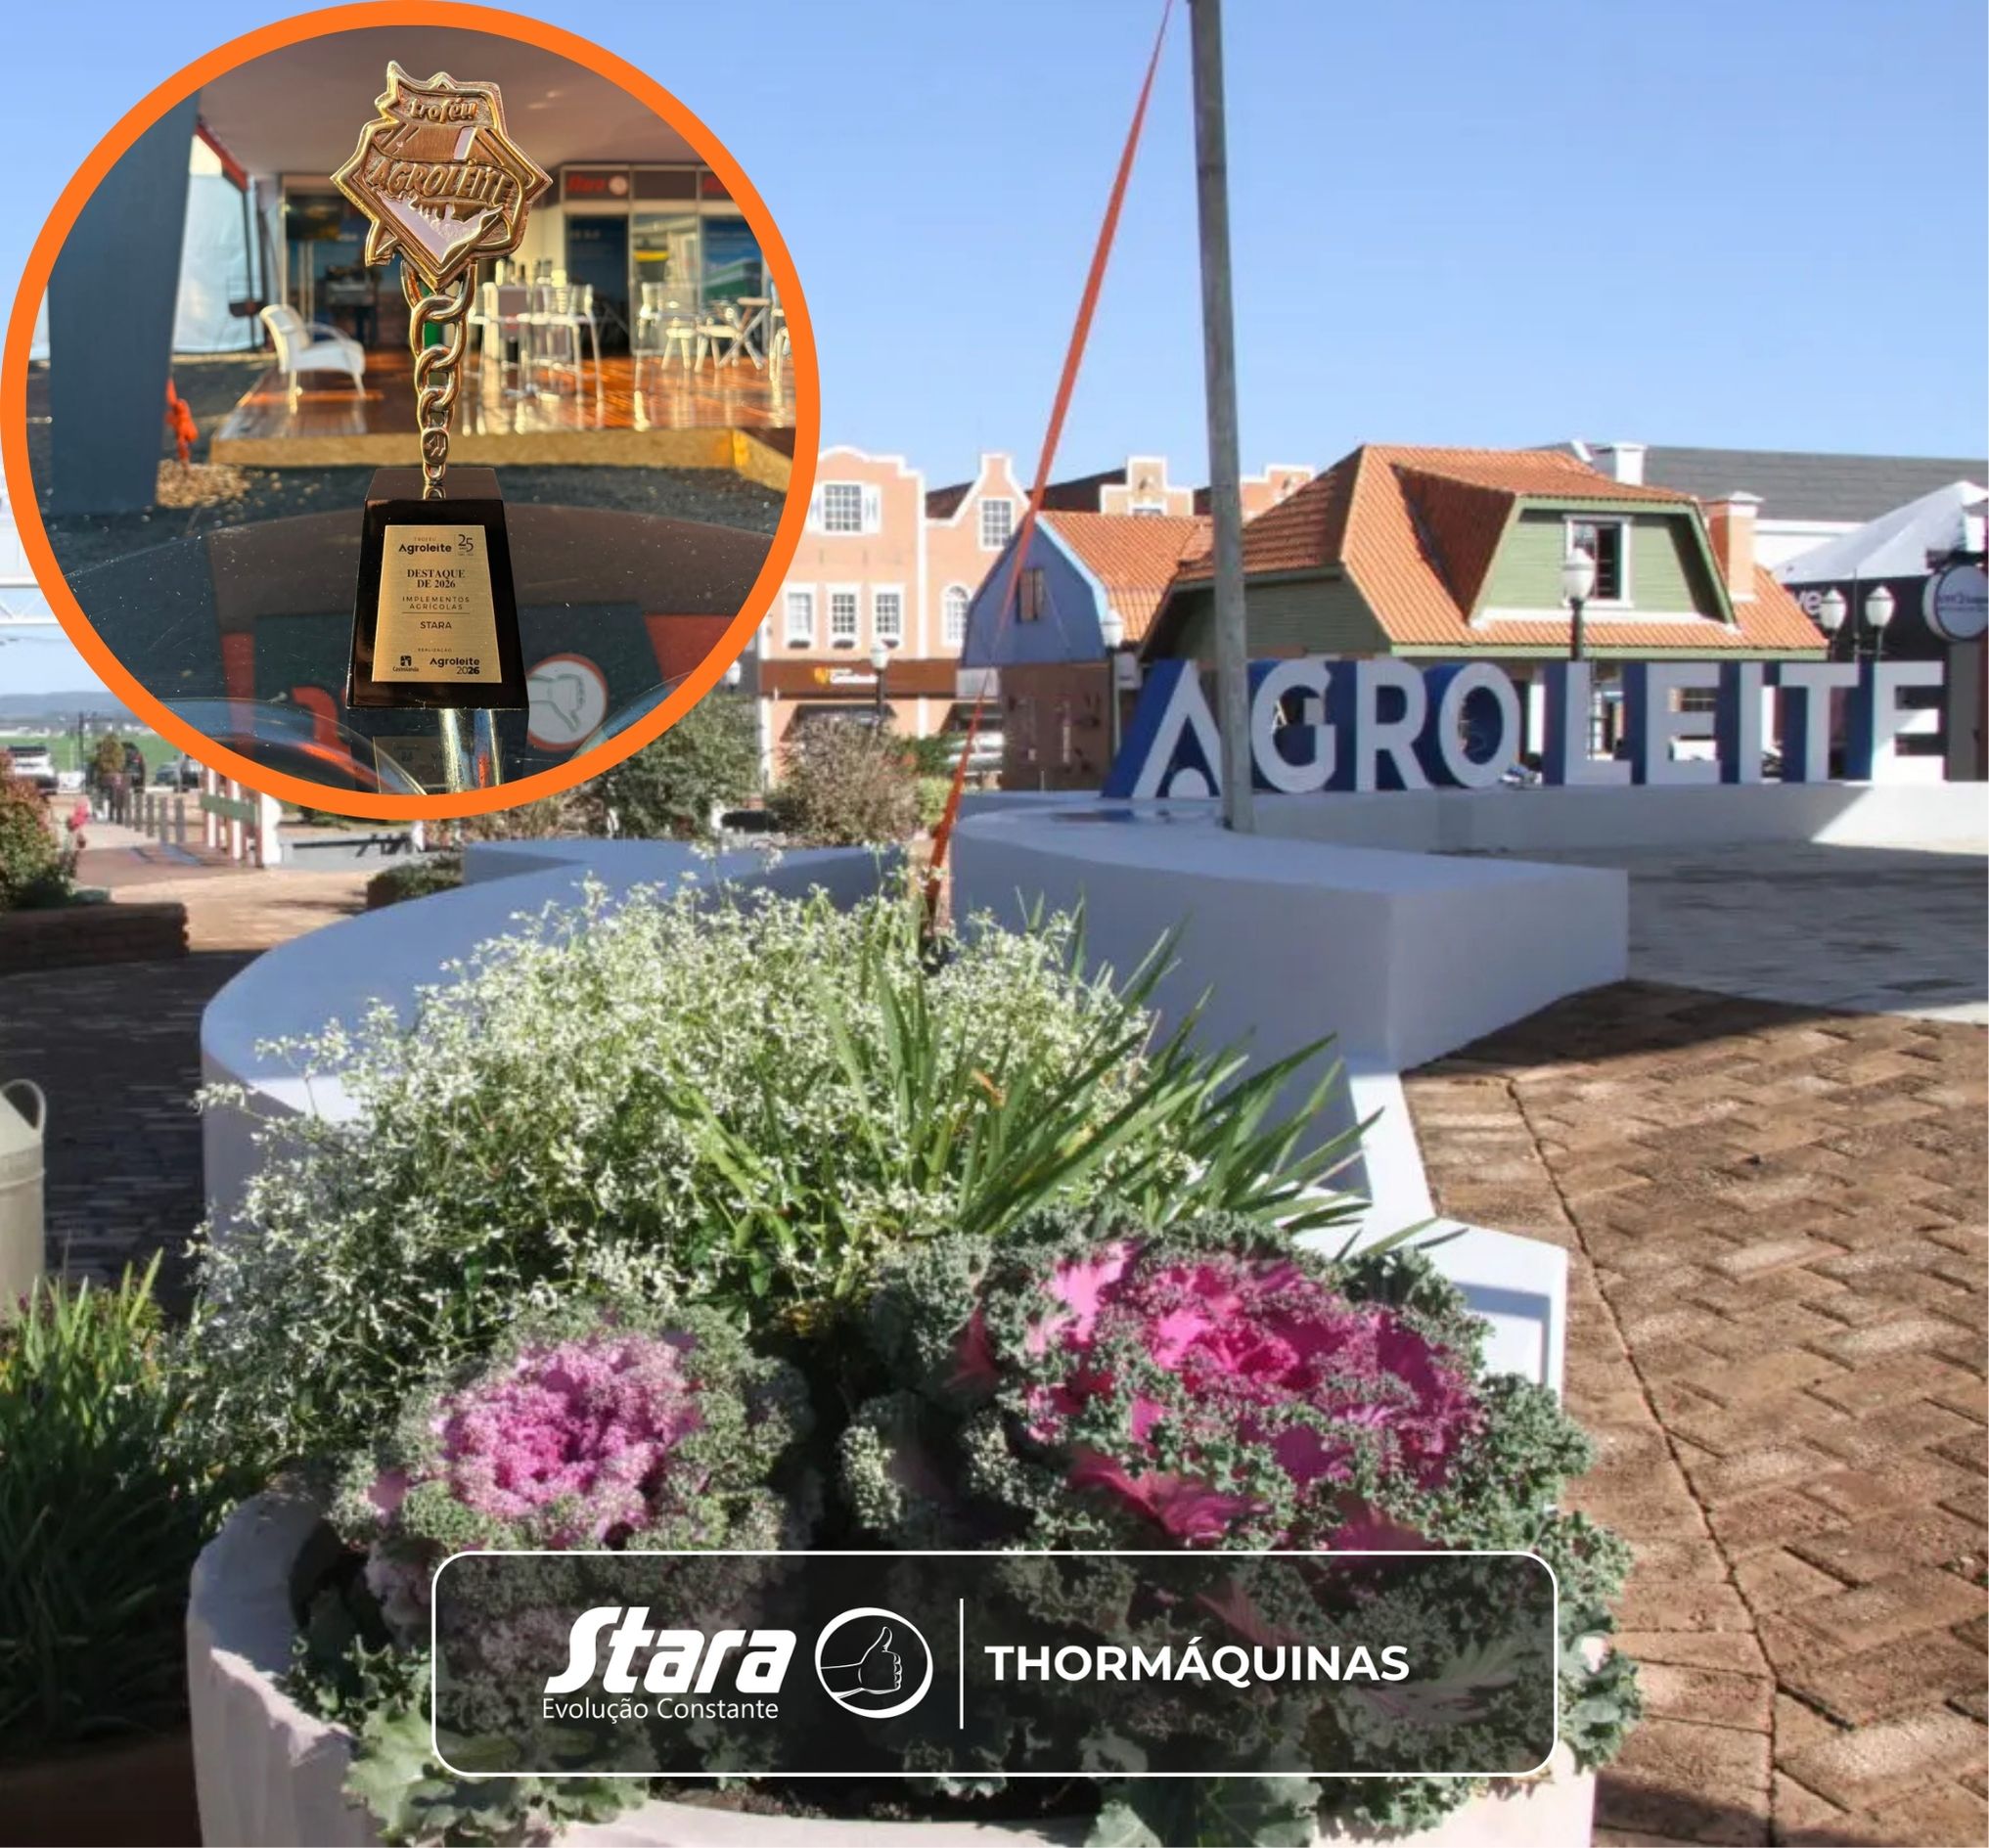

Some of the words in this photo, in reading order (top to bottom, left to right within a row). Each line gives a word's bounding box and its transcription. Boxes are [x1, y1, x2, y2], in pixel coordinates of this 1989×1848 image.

[410, 98, 478, 123] troféu
[398, 543, 452, 555] Agroleite
[458, 534, 475, 553] 25
[407, 568, 466, 580] DESTAQUE
[417, 579, 431, 588] DE
[434, 579, 456, 588] 2026
[420, 620, 452, 629] STARA
[429, 656, 480, 667] Agroleite
[456, 666, 480, 675] 2026
